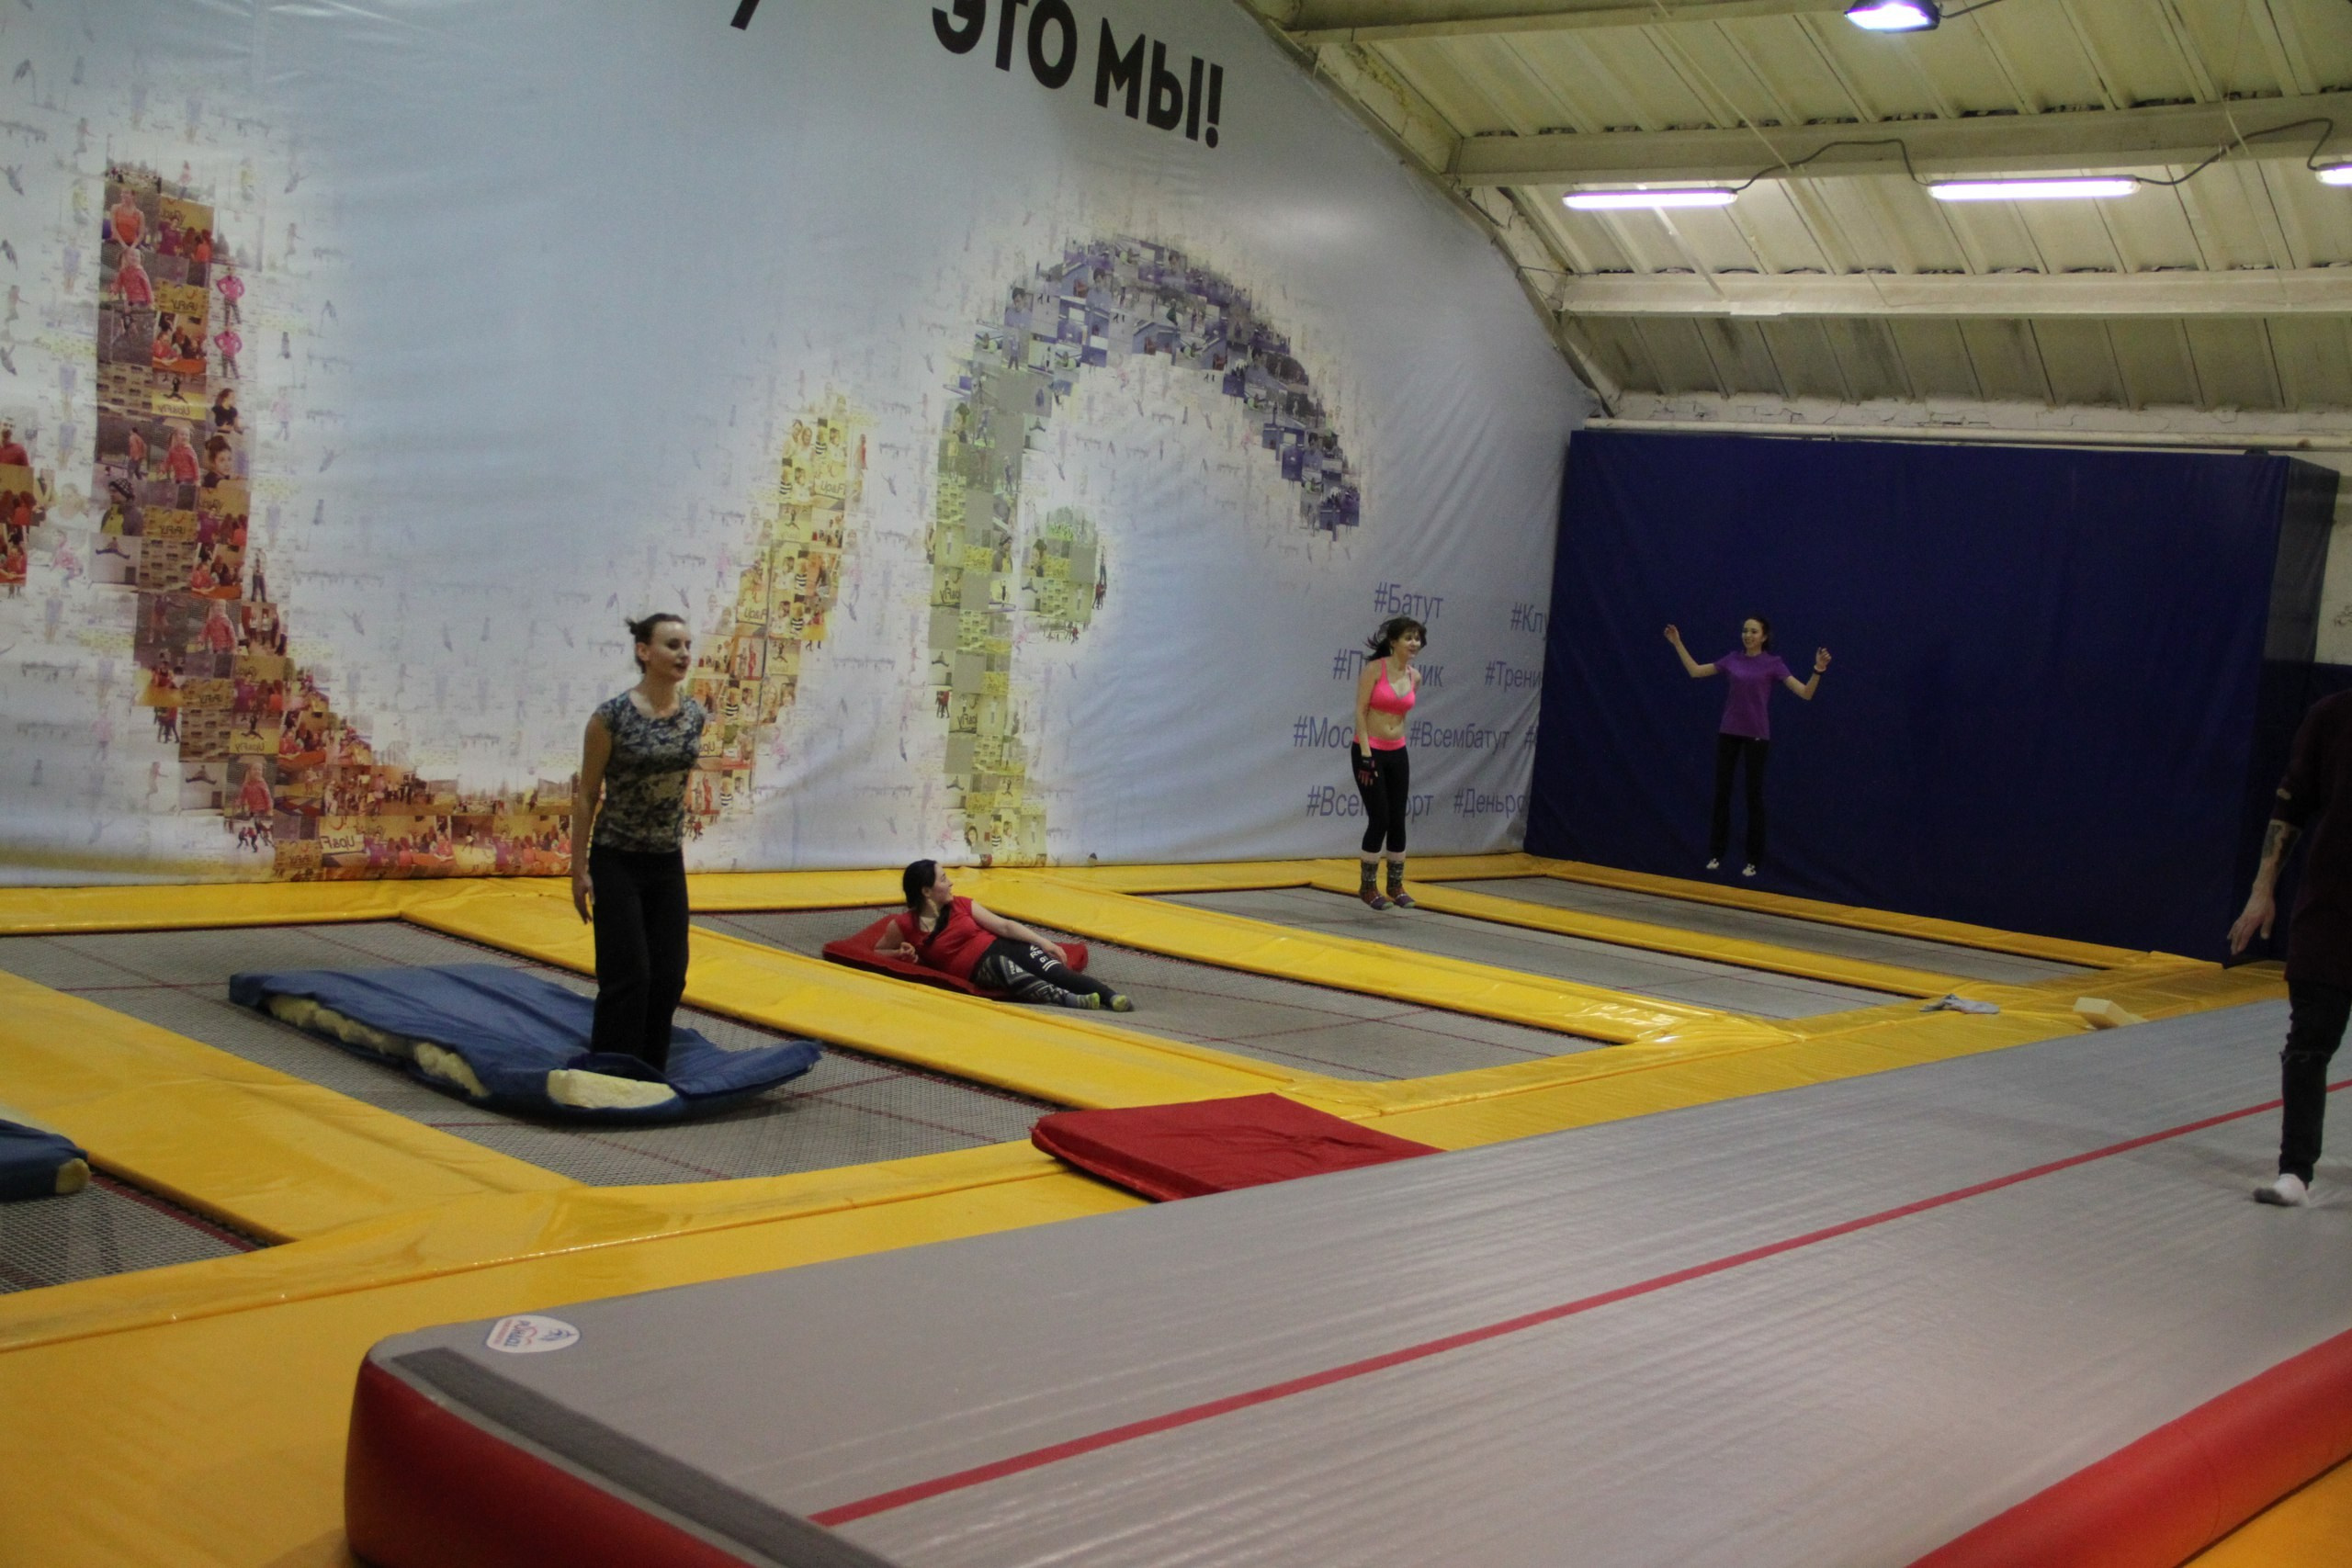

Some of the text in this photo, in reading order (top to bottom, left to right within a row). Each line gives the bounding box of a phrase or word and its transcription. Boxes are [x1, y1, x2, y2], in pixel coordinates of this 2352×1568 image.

[1374, 581, 1443, 626] #Батут
[1485, 660, 1543, 693] #Трени
[1294, 715, 1353, 749] #Мос
[1409, 720, 1511, 755] #Всембатут
